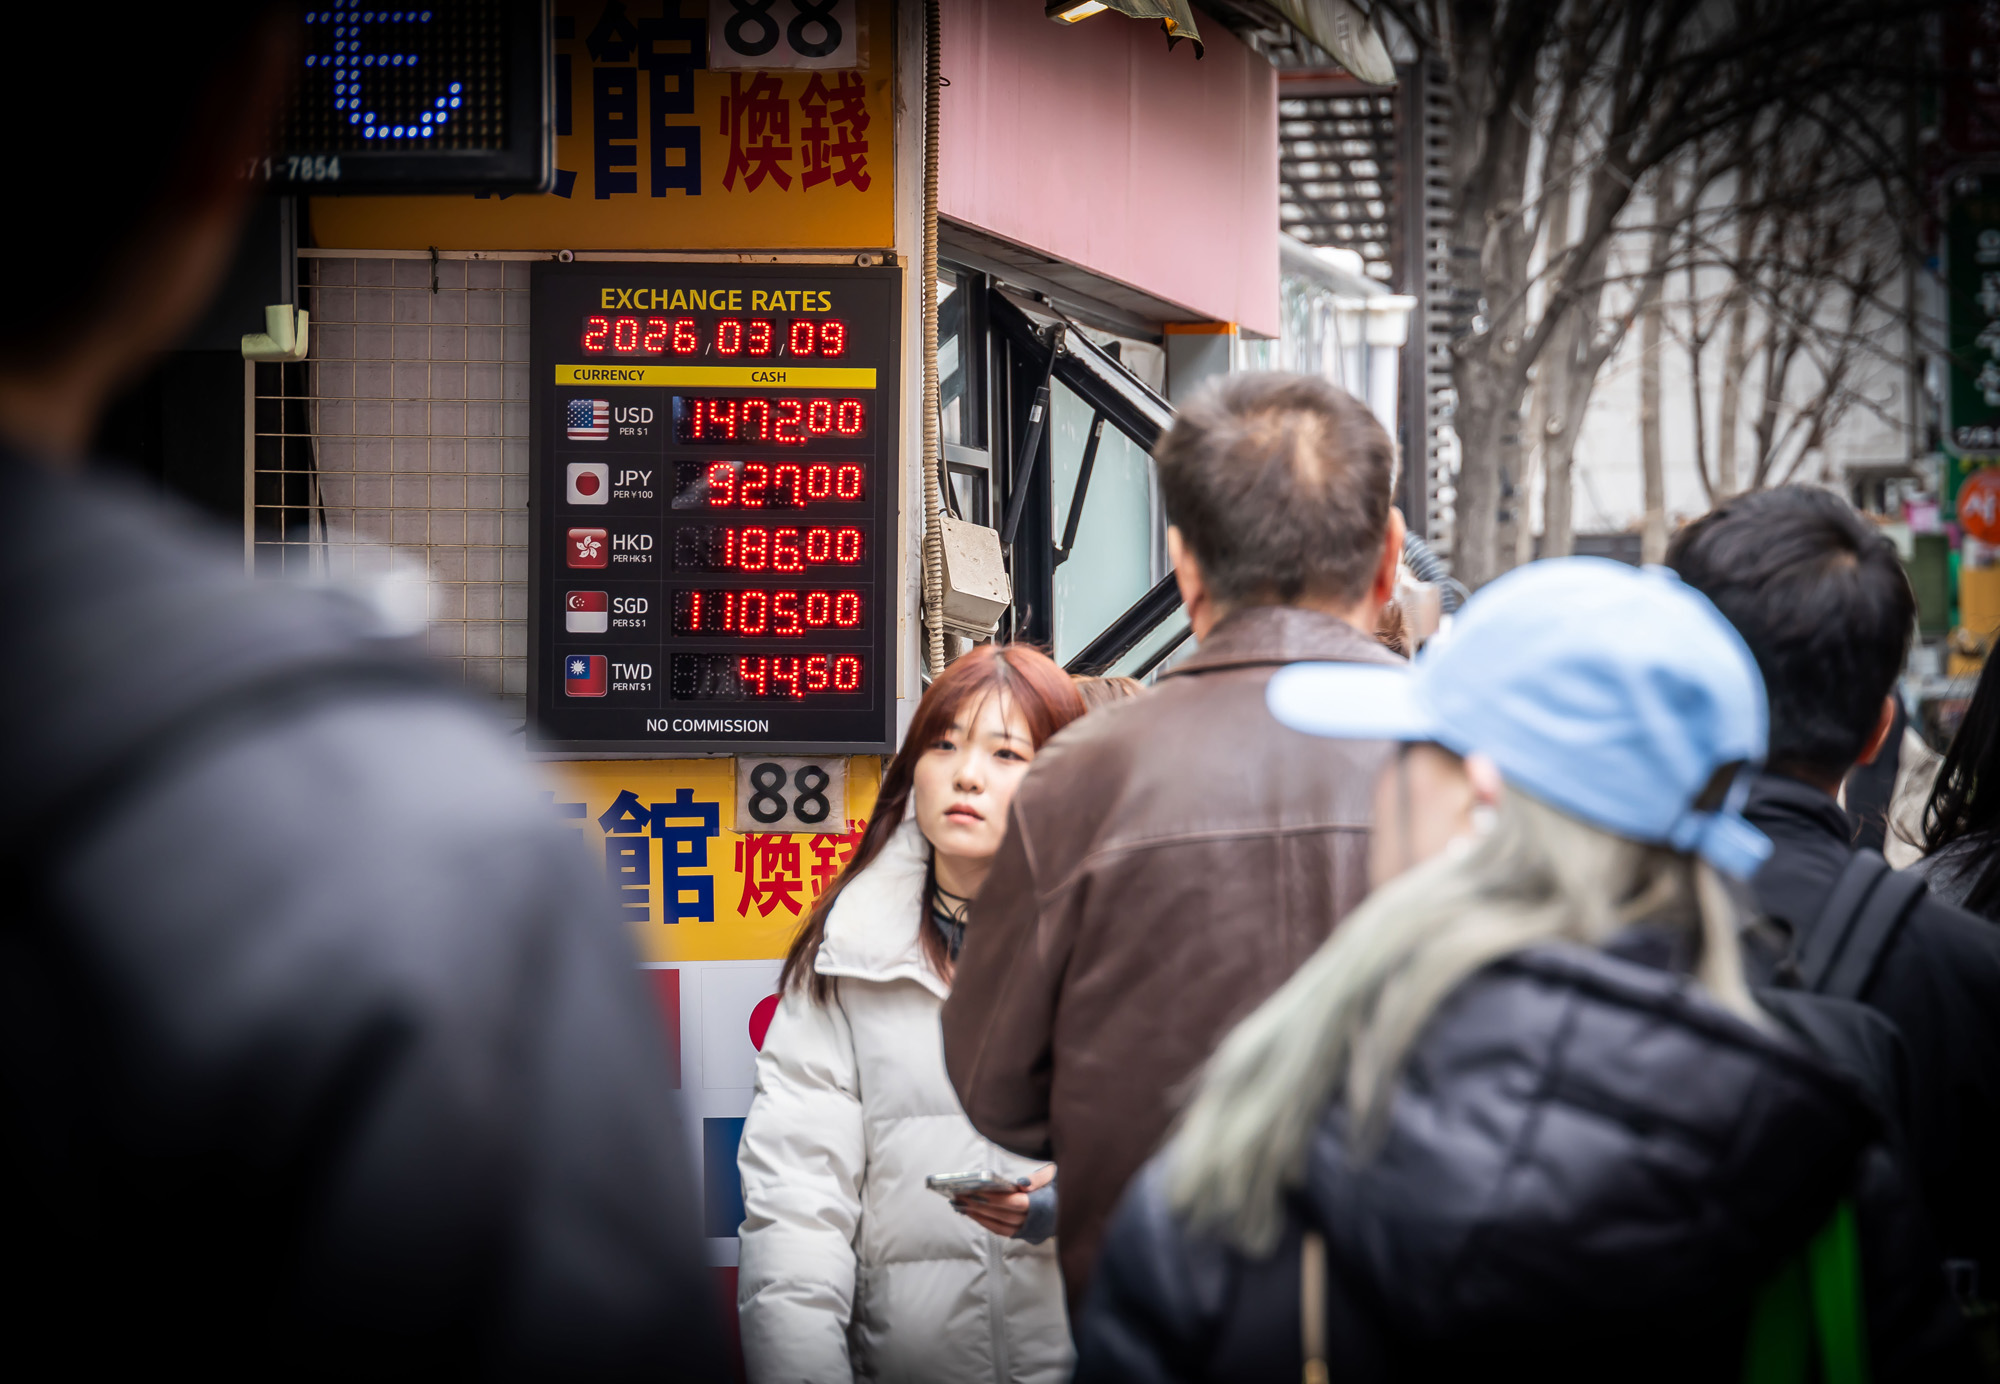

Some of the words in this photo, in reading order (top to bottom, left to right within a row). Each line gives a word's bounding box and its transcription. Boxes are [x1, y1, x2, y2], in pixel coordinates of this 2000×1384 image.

[723, 0, 843, 58] 88
[236, 155, 341, 183] 71-7854
[601, 288, 743, 311] EXCHANGE
[751, 290, 832, 312] RATES
[573, 368, 646, 381] CURRENCY
[751, 371, 787, 383] CASH
[614, 407, 654, 424] USD
[619, 427, 635, 436] PER
[614, 470, 653, 486] JPY
[613, 490, 629, 499] PER
[631, 490, 653, 499] ¥100
[612, 534, 653, 550] HKD
[613, 555, 628, 563] PER
[613, 598, 648, 614] SGD
[612, 619, 628, 627] PER
[612, 664, 652, 680] TWD
[612, 683, 628, 691] PER
[646, 719, 669, 732] NO
[672, 719, 769, 733] COMMISSION
[748, 762, 830, 824] 88
